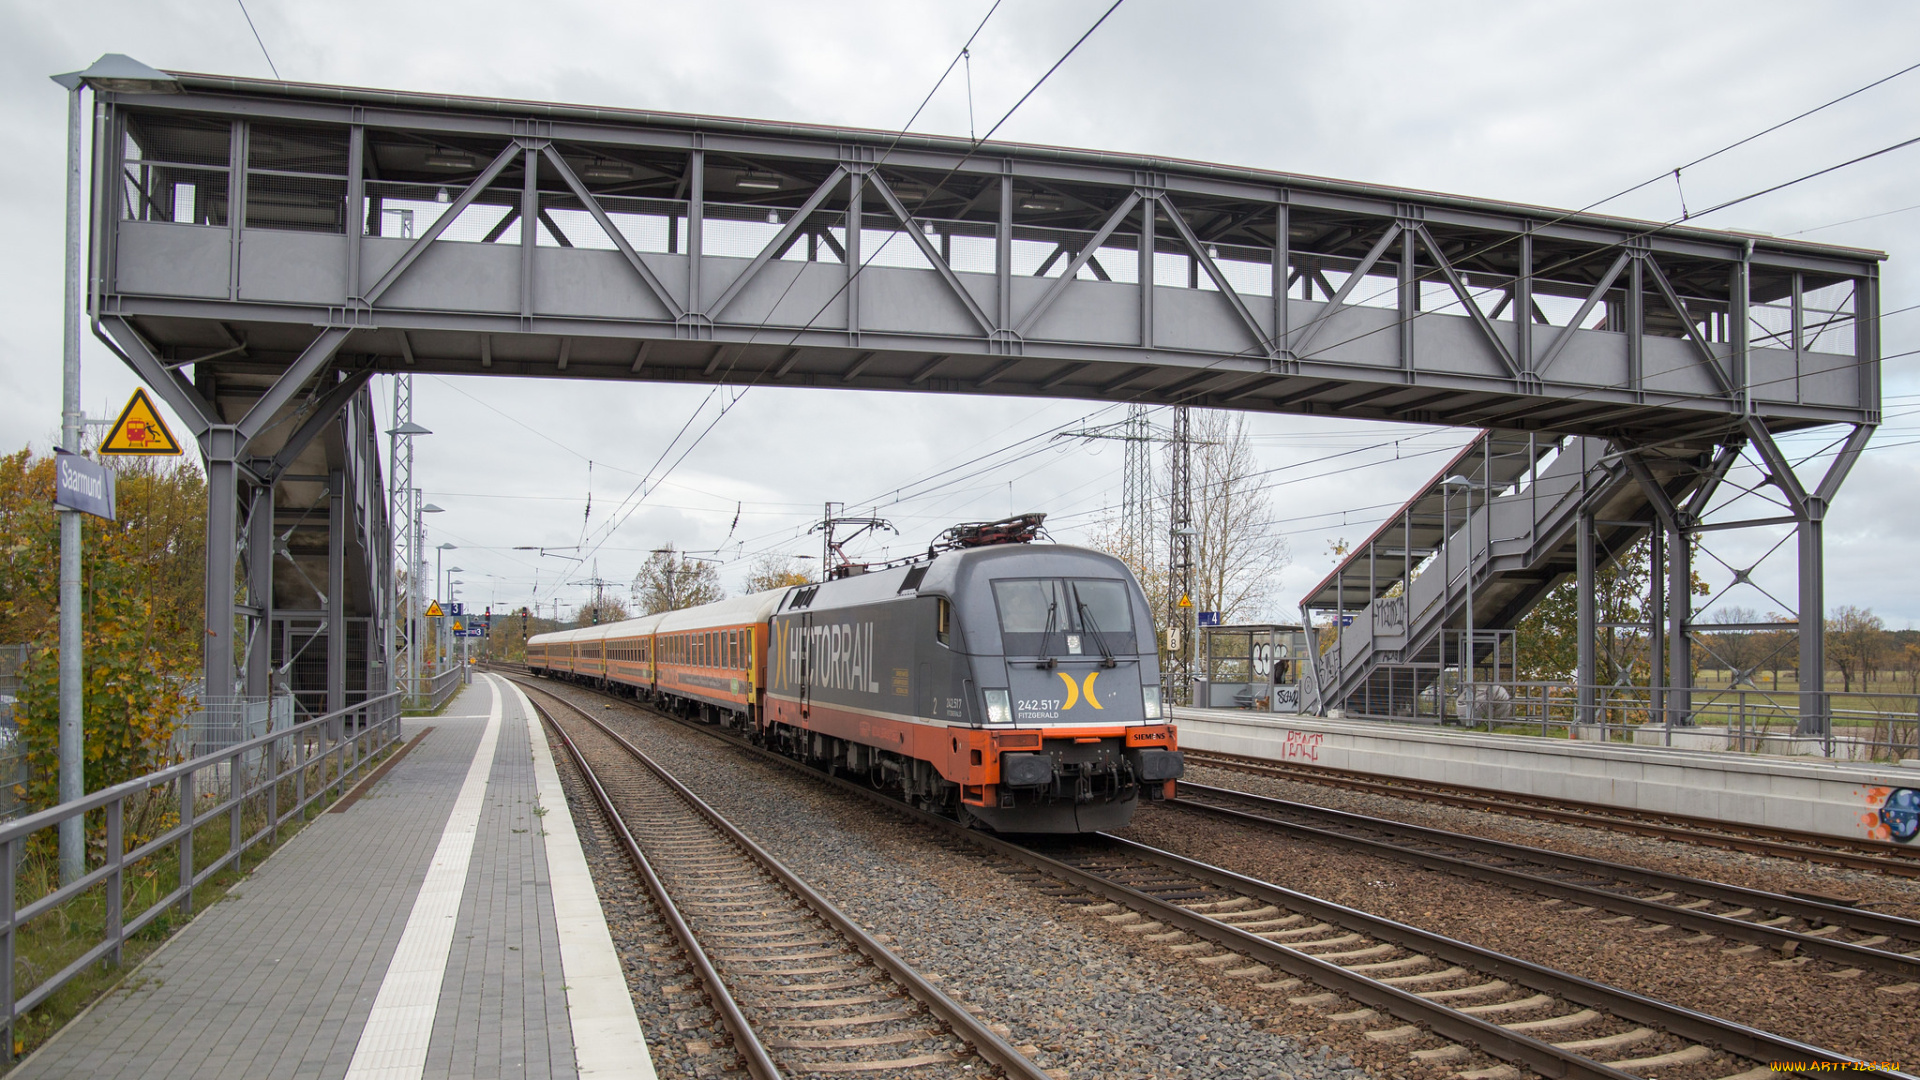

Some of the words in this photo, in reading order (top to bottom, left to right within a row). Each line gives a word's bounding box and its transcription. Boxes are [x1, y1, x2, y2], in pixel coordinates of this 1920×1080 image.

[62, 459, 102, 500] Saarmund
[452, 603, 459, 614] 3
[1211, 612, 1218, 625] 4
[1171, 628, 1176, 638] 7
[1170, 638, 1177, 649] 8
[789, 621, 880, 694] HECTORRAIL
[932, 697, 938, 715] 2
[1018, 699, 1060, 711] 242.517
[1018, 711, 1059, 719] FITZGERALD
[1133, 732, 1166, 741] SIEMENS
